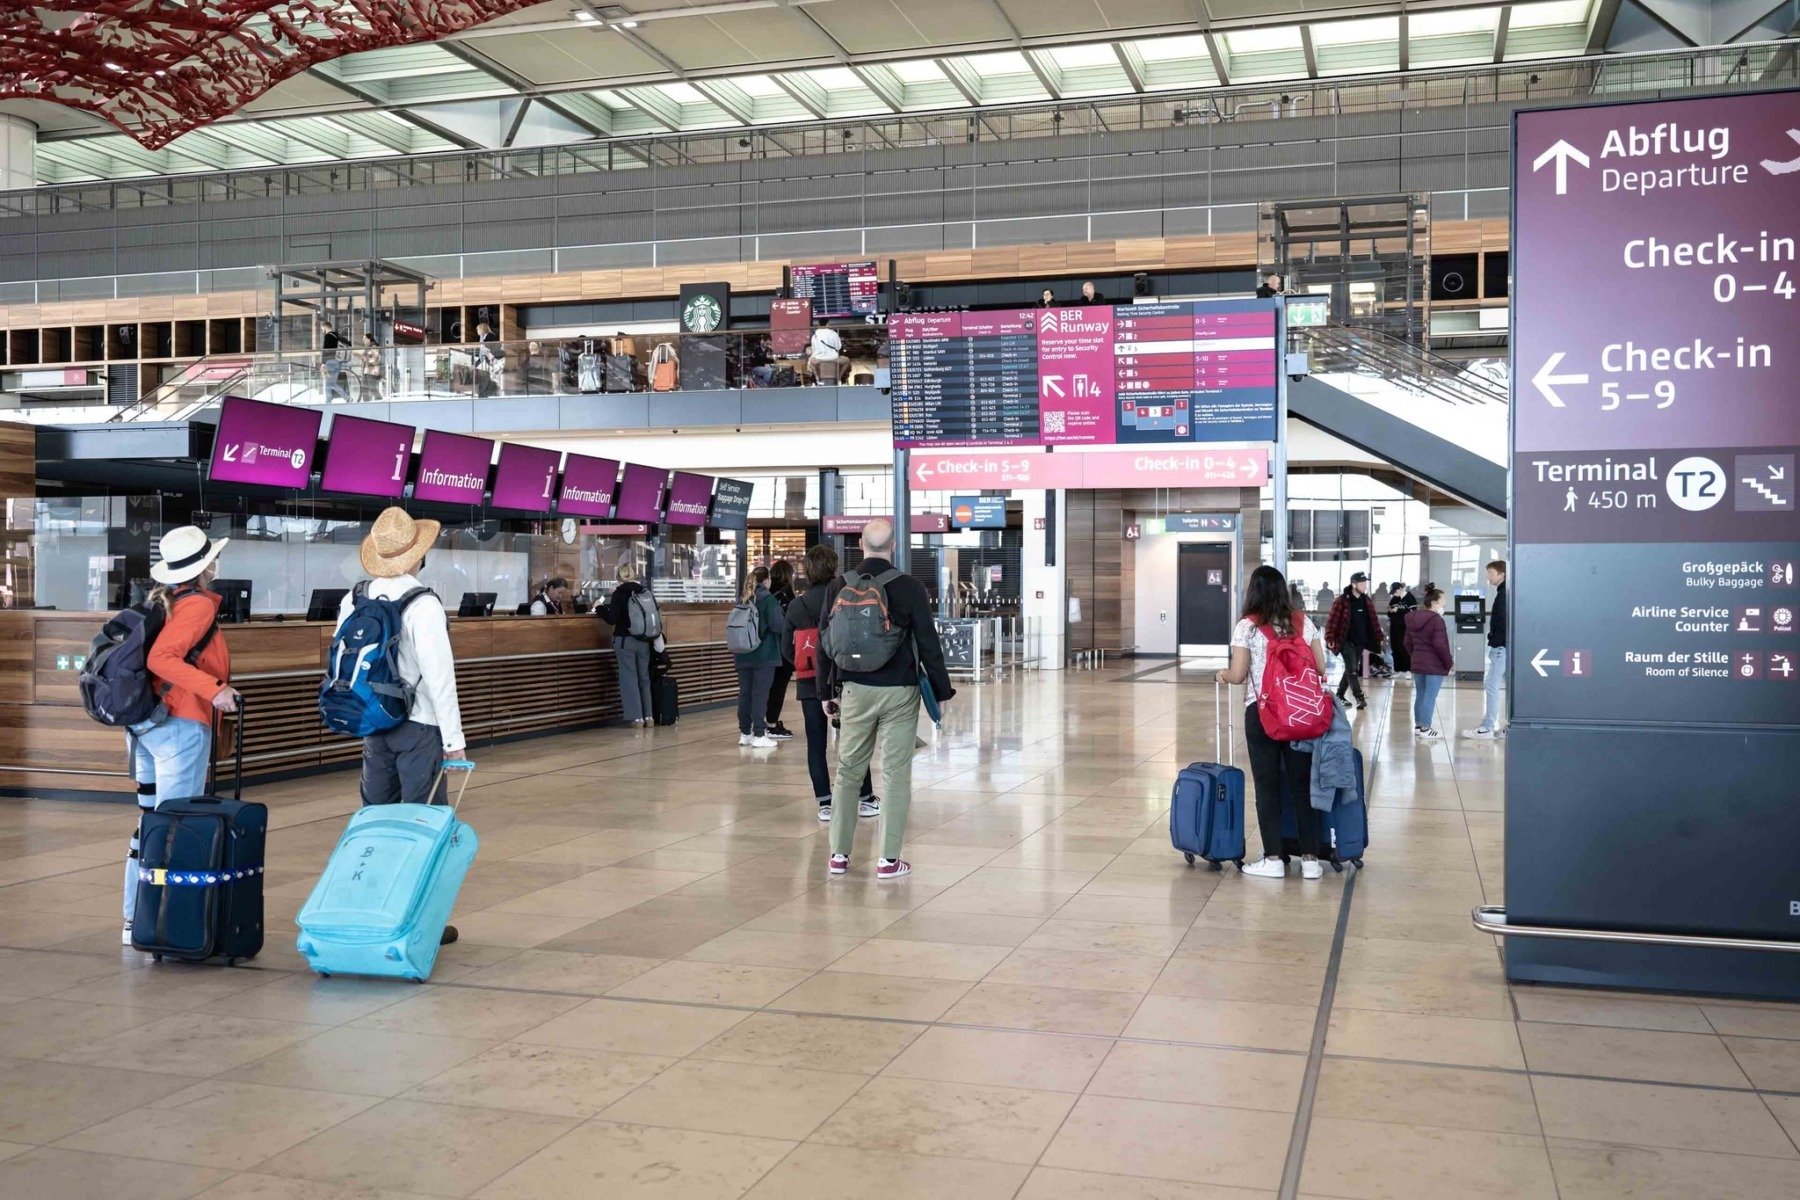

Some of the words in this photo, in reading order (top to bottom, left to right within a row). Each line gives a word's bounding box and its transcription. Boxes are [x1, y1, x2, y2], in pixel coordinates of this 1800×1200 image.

[1600, 124, 1730, 160] Abflug
[1602, 160, 1749, 196] Departure
[1624, 231, 1795, 268] Check-in
[904, 317, 925, 325] Abflug
[1060, 310, 1083, 320] BER
[1060, 322, 1109, 334] Runway
[1601, 336, 1772, 373] Check-in
[1090, 381, 1102, 397] 4
[260, 446, 291, 459] Terminal
[293, 452, 304, 465] T2
[937, 460, 998, 473] Check-in
[1134, 456, 1200, 471] Check-in
[421, 468, 484, 490] Information
[1532, 456, 1658, 482] Terminal
[1674, 471, 1717, 498] T2
[562, 486, 611, 504] Information
[1588, 490, 1628, 510] 450
[1637, 493, 1657, 508] m
[670, 500, 707, 515] Information
[938, 518, 944, 528] 3
[1682, 560, 1764, 576] Großgepäck
[1686, 576, 1715, 588] Bulky
[1718, 577, 1764, 590] Baggage
[1632, 606, 1677, 618] Airline
[1680, 606, 1729, 618] Service
[1675, 620, 1729, 633] Counter
[1625, 652, 1664, 664] Raum
[1667, 651, 1690, 663] der
[1693, 651, 1729, 664] Stille
[1645, 666, 1674, 678] Room
[1677, 666, 1689, 678] of
[1691, 666, 1729, 678] Silence
[360, 846, 374, 858] B
[352, 870, 363, 880] K
